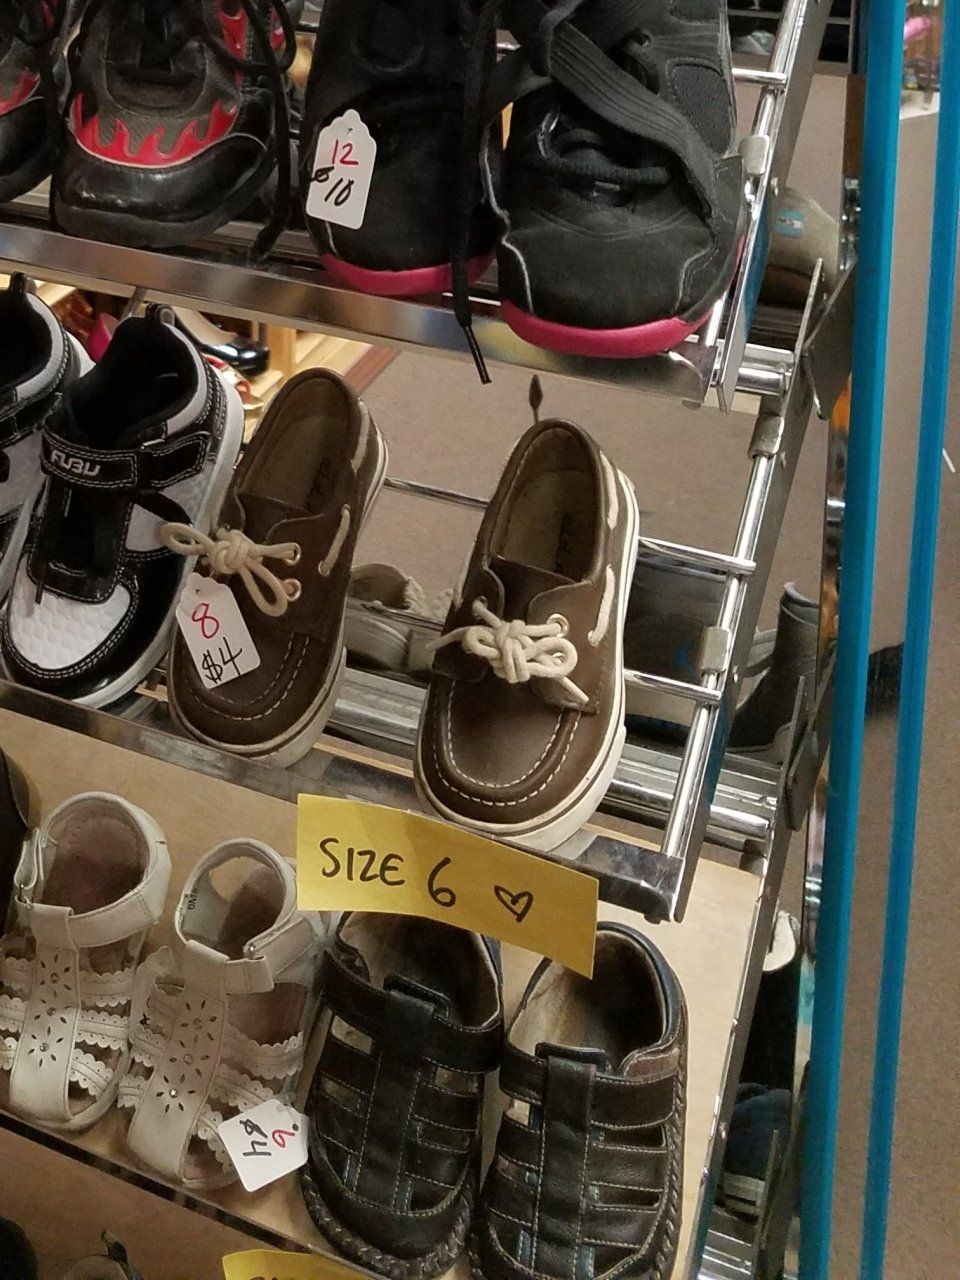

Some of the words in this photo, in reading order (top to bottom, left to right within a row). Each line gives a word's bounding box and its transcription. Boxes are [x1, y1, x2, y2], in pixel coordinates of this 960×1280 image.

[331, 138, 360, 166] 12
[310, 165, 355, 207] $10
[50, 449, 101, 477] FUBU
[192, 602, 220, 639] 8
[201, 636, 243, 685] $4
[318, 837, 406, 887] SIZE
[427, 856, 457, 908] 6
[239, 1118, 272, 1157] $4
